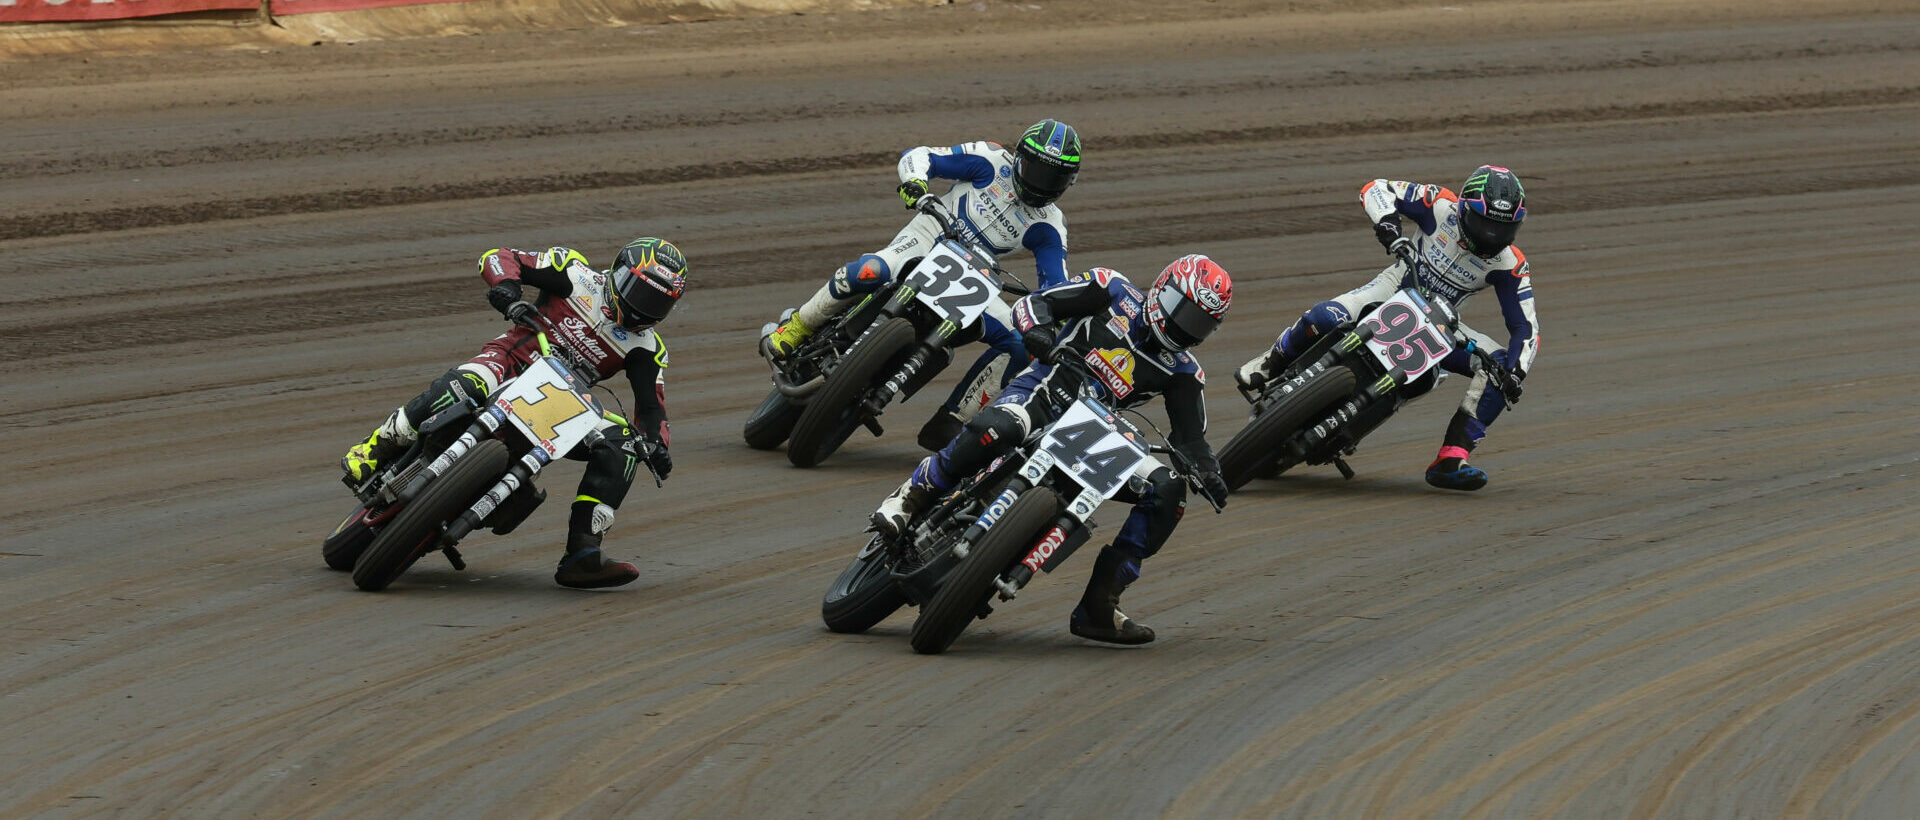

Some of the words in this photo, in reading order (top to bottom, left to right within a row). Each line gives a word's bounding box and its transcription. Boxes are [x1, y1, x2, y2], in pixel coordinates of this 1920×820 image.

[979, 192, 1020, 239] ESTENSON
[657, 266, 670, 278] BELL
[834, 266, 851, 294] 32
[1431, 245, 1477, 282] ESTENSON
[911, 254, 990, 323] 32
[1199, 288, 1222, 309] Arai
[563, 317, 608, 359] Indian
[1365, 302, 1449, 376] 95
[1086, 352, 1130, 396] MISSION
[498, 398, 513, 415] RK
[509, 381, 590, 441] 1
[540, 439, 556, 456] RK
[1043, 418, 1144, 496] 44
[977, 488, 1019, 531] LIQUI
[1027, 527, 1066, 571] MOLY
